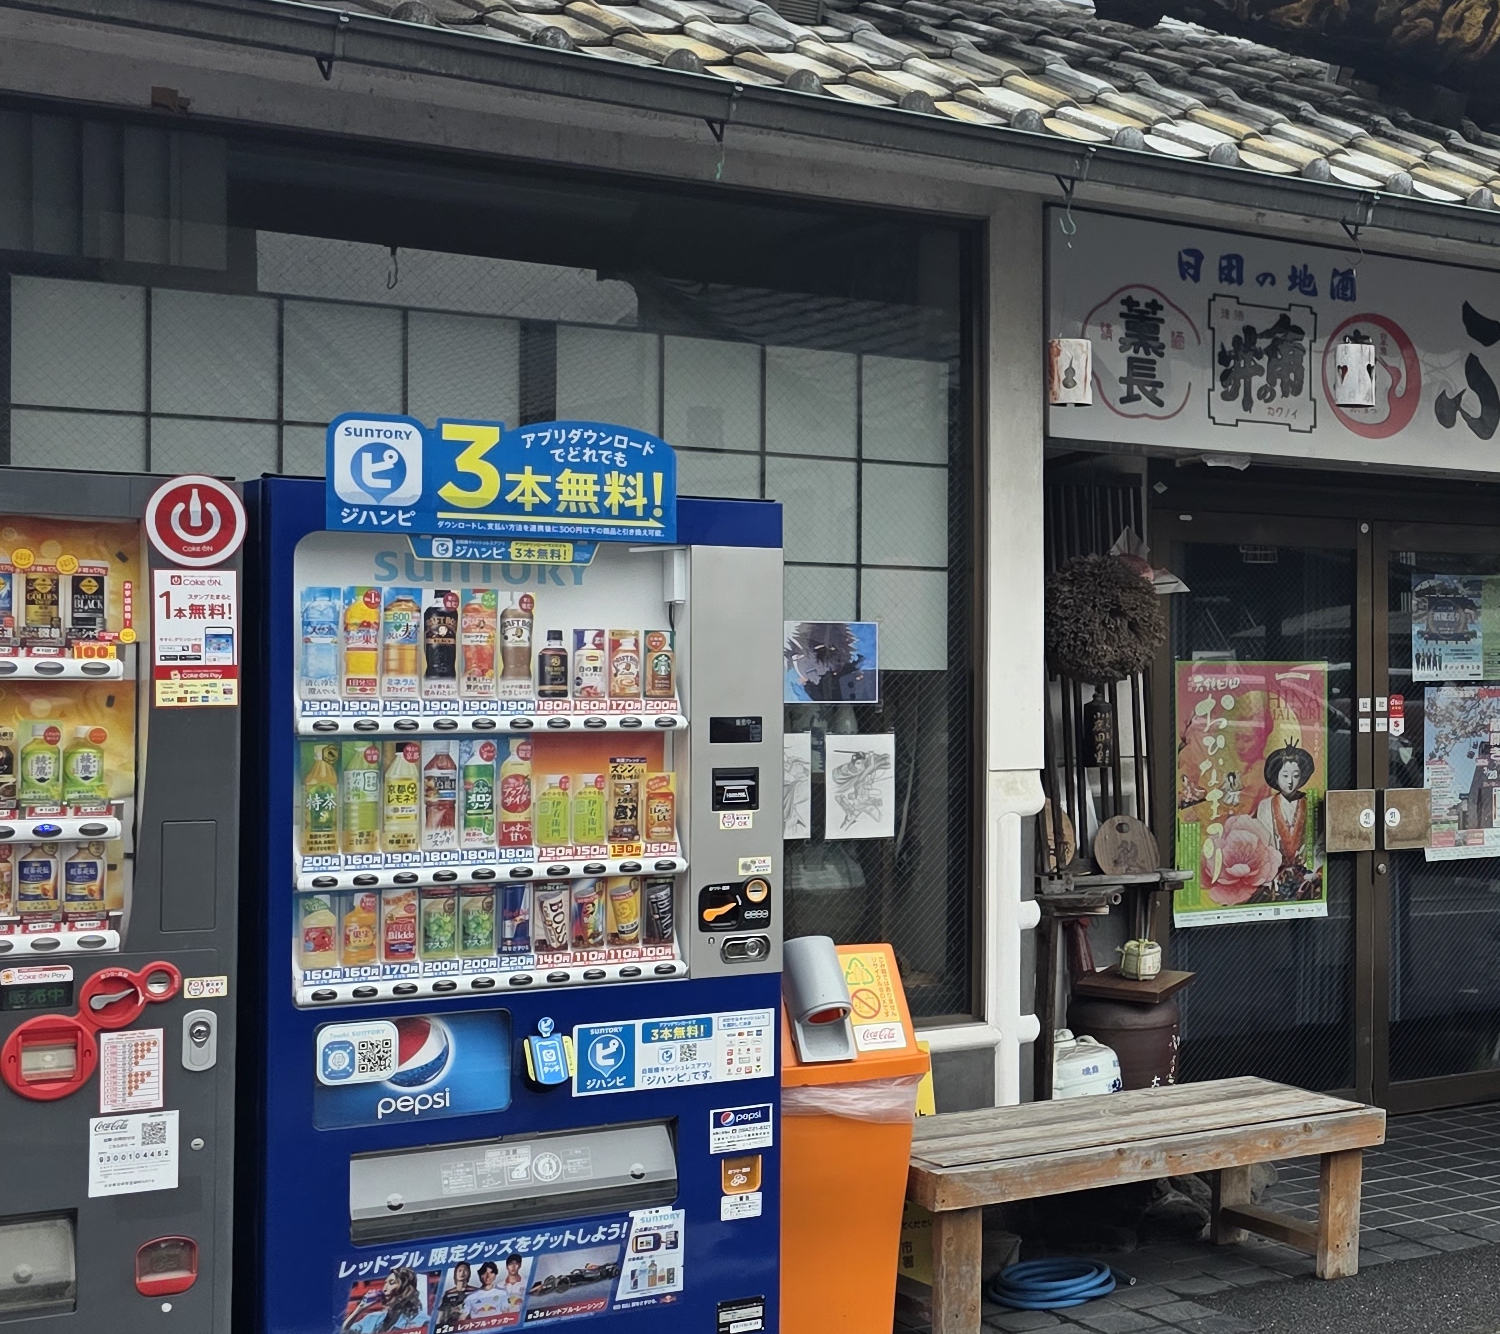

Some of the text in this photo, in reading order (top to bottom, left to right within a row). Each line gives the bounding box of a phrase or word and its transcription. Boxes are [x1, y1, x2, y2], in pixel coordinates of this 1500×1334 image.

[1177, 248, 1357, 302] 日田の地酒
[1119, 296, 1166, 408] 薫長
[344, 426, 412, 440] SUNTORY
[521, 428, 656, 457] アプリダウンロード
[550, 446, 628, 467] でどれでも
[361, 449, 399, 489] ピ
[437, 423, 663, 517] 3本無料!
[340, 507, 416, 527] ジハンピ
[455, 547, 505, 559] ジハンピ
[515, 548, 567, 560] 3本無料!
[183, 578, 205, 586] Coke
[75, 599, 103, 609] BLACK
[159, 591, 232, 620] 1本無料!
[393, 612, 409, 621] 600
[304, 701, 339, 711] 130円
[344, 701, 378, 711] 190円
[385, 701, 419, 711] 150円
[424, 701, 458, 711] 190円
[464, 701, 497, 711] 190円
[502, 701, 534, 711] 190円
[539, 701, 570, 710] 180円
[575, 701, 606, 710] 160円
[611, 701, 642, 710] 170円
[646, 701, 676, 710] 200円
[387, 785, 406, 794] 京都
[1195, 693, 1236, 884] おひなまつり
[306, 793, 337, 811] 特茶
[387, 794, 418, 804] レモネード
[468, 794, 492, 803] メロン
[471, 802, 491, 810] ソーダ
[510, 833, 528, 842] 甘い
[541, 847, 573, 856] 150円
[575, 846, 606, 855] 150円
[645, 843, 676, 852] 160円
[386, 853, 420, 863] 190円
[425, 851, 459, 861] 180円
[462, 850, 495, 859] 180円
[501, 849, 532, 858] 180円
[304, 856, 339, 866] 200円
[346, 855, 380, 864] 160円
[549, 899, 568, 944] BOSS
[576, 952, 606, 961] 110円
[610, 950, 640, 959] 110円
[642, 947, 672, 956] 100円
[464, 959, 497, 969] 200円
[501, 956, 534, 966] 220円
[539, 954, 570, 964] 140円
[344, 967, 379, 977] 160円
[384, 964, 418, 974] 170円
[424, 962, 458, 972] 200円
[52, 972, 66, 980] Pay
[305, 970, 341, 980] 160円
[9, 988, 65, 1004] 販売中
[352, 1028, 386, 1037] SUNTORY
[590, 1027, 623, 1035] SUNTORY
[651, 1024, 705, 1041] 3本無料!
[596, 1039, 619, 1066] ピ
[586, 1076, 627, 1089] ジハンピ
[642, 1070, 713, 1086] 「ジハンピ」です。
[377, 1087, 451, 1119] pepsi
[736, 1110, 761, 1122] pepsi
[640, 1212, 680, 1224] SUNTORY
[338, 1221, 628, 1279] レッドブル 限定グッズをゲットしよう!
